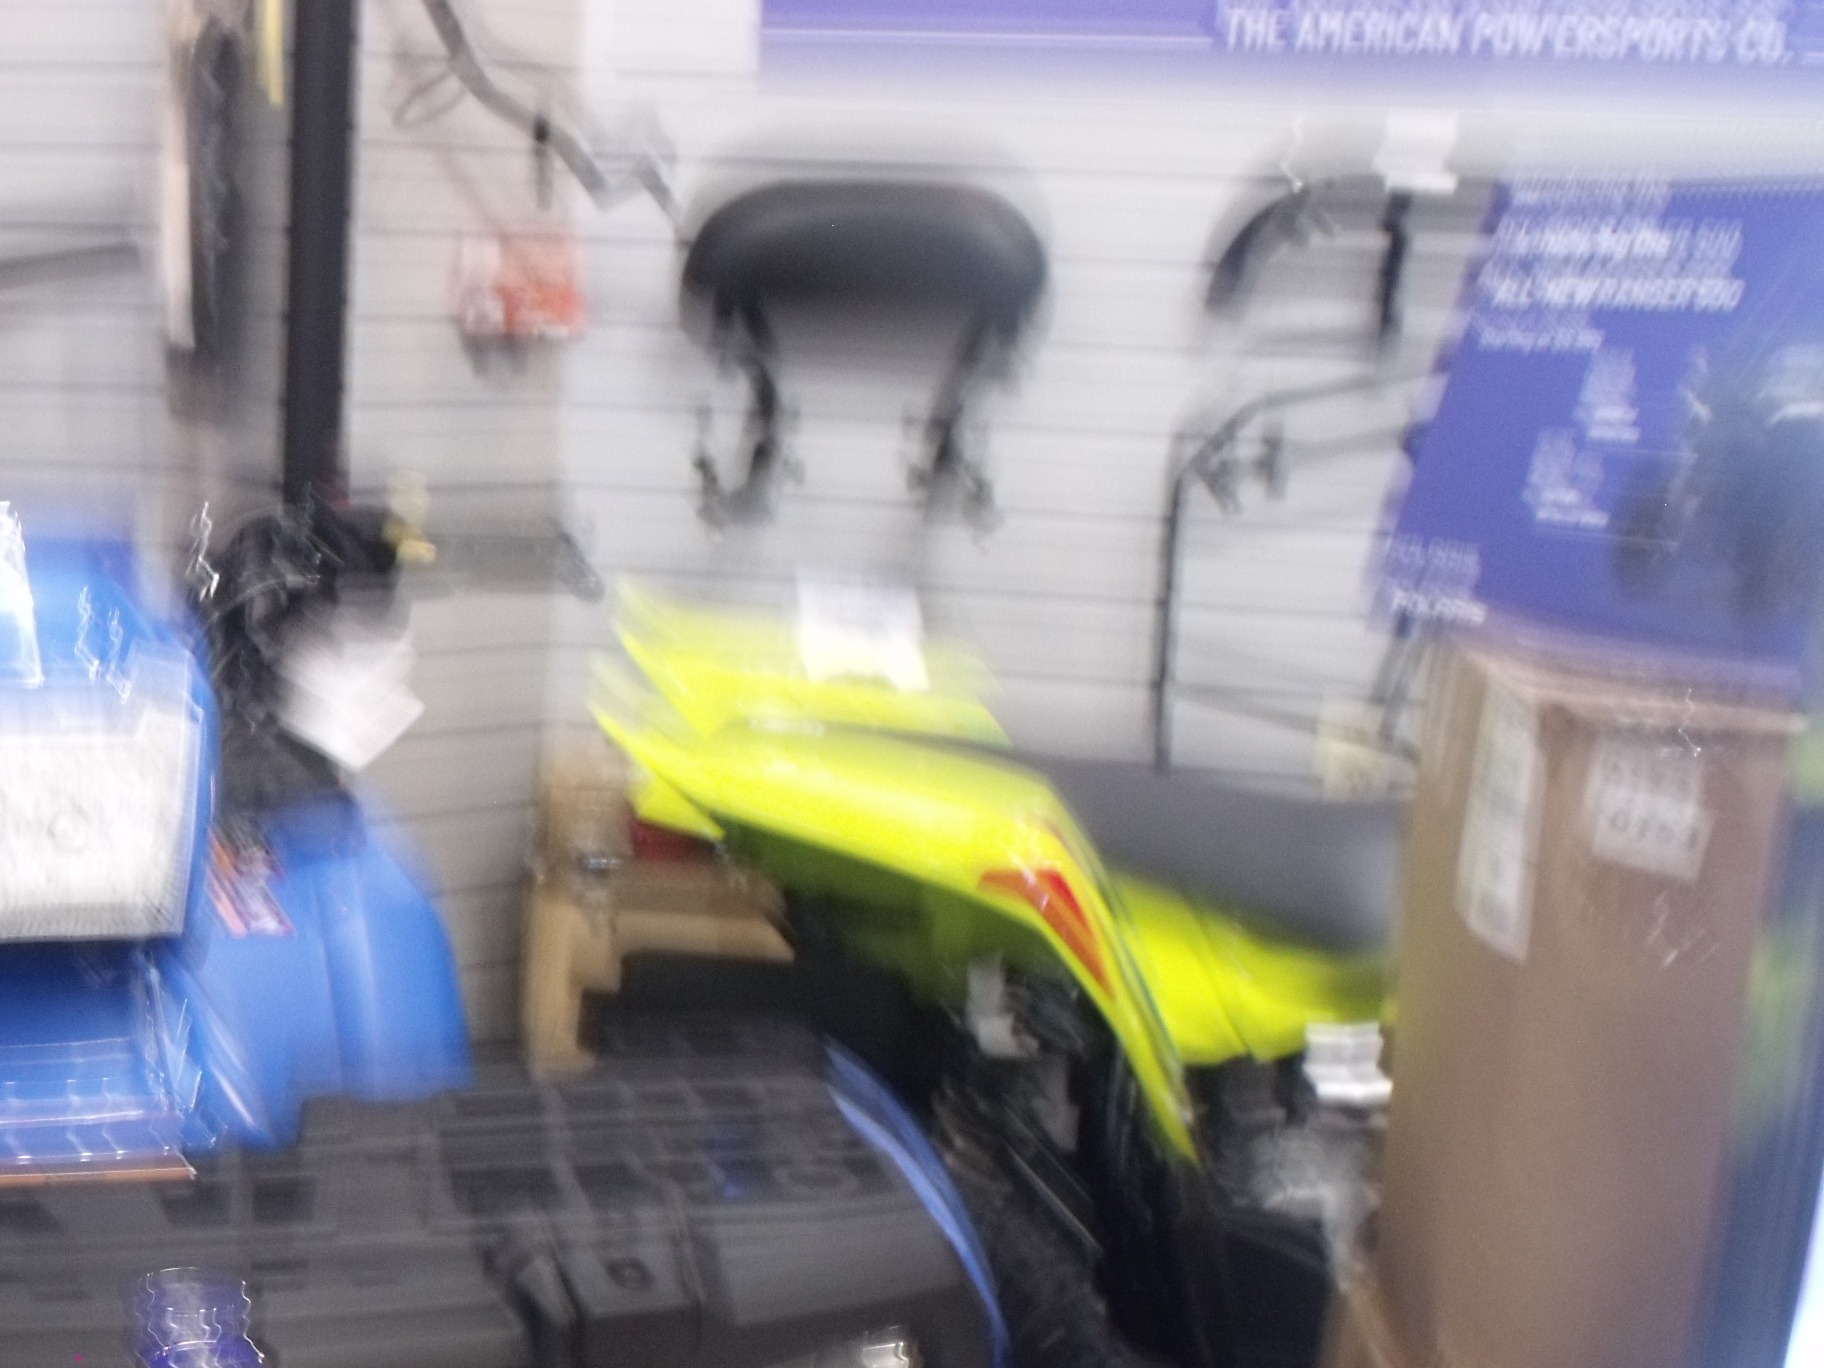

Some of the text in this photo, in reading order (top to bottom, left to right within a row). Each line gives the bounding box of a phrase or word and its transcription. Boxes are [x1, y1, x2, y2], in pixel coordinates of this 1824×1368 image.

[1227, 9, 1285, 51] THE
[1295, 9, 1463, 54] AMERICAN
[1470, 11, 1732, 60] POWERSPORTS
